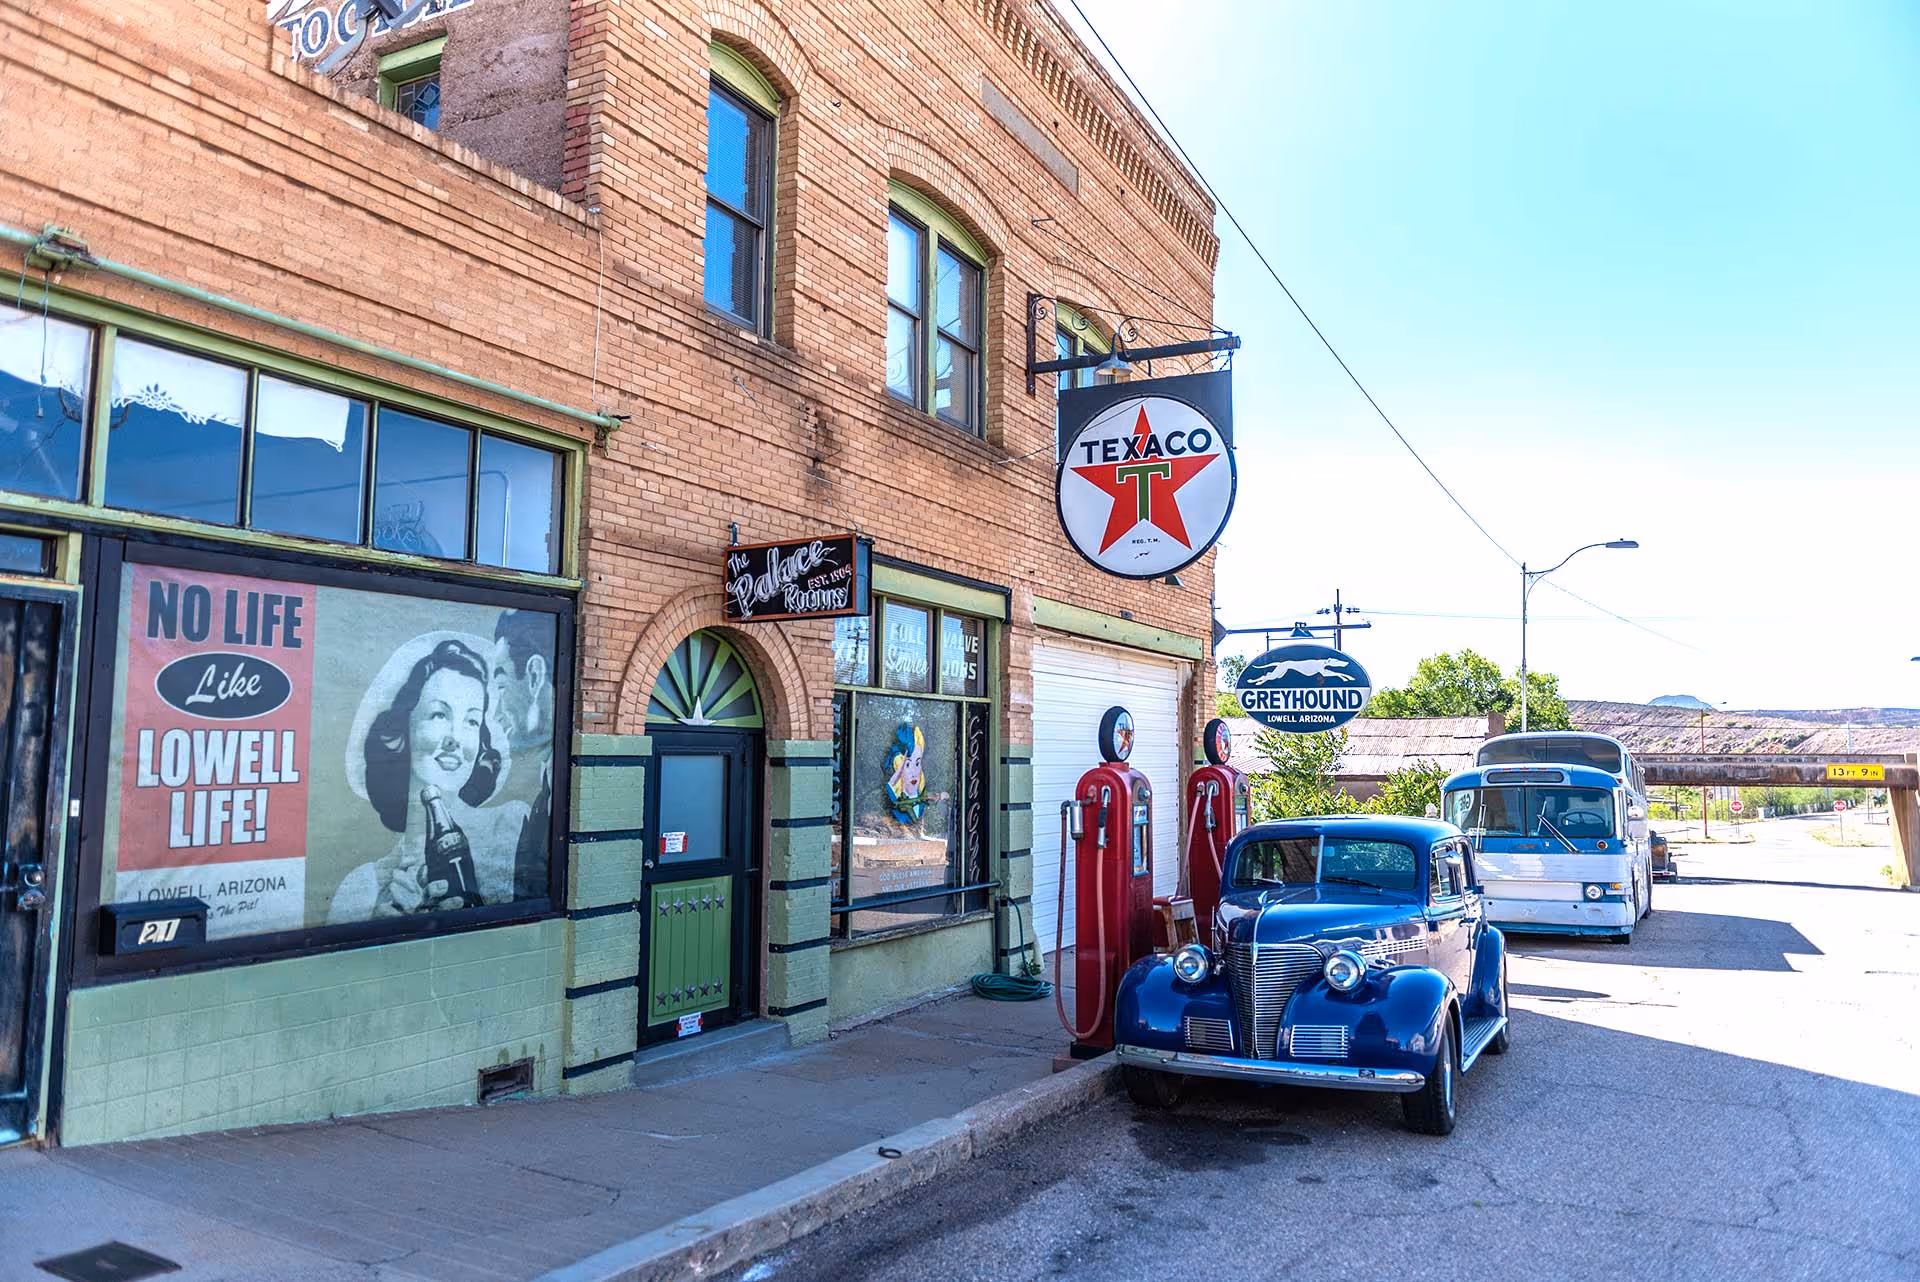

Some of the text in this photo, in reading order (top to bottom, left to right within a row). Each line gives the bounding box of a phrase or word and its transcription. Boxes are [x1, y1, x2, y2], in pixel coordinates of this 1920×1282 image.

[1080, 428, 1212, 464] TEXACO
[1117, 462, 1170, 522] T
[725, 540, 837, 620] Palace
[728, 552, 750, 578] The
[781, 577, 851, 614] Rooms
[808, 573, 830, 590] EST.
[146, 580, 304, 649] NO LIFE
[890, 623, 925, 646] FULL
[943, 632, 978, 653] VALVE
[185, 662, 262, 706] Like
[942, 660, 977, 680] JOBS
[1241, 690, 1363, 709] GREYHOUND
[1267, 715, 1336, 723] LOWELL ARIZONA
[136, 728, 300, 788] LOWELL
[169, 787, 269, 849] LIFE!
[217, 876, 287, 897] ARIZONA
